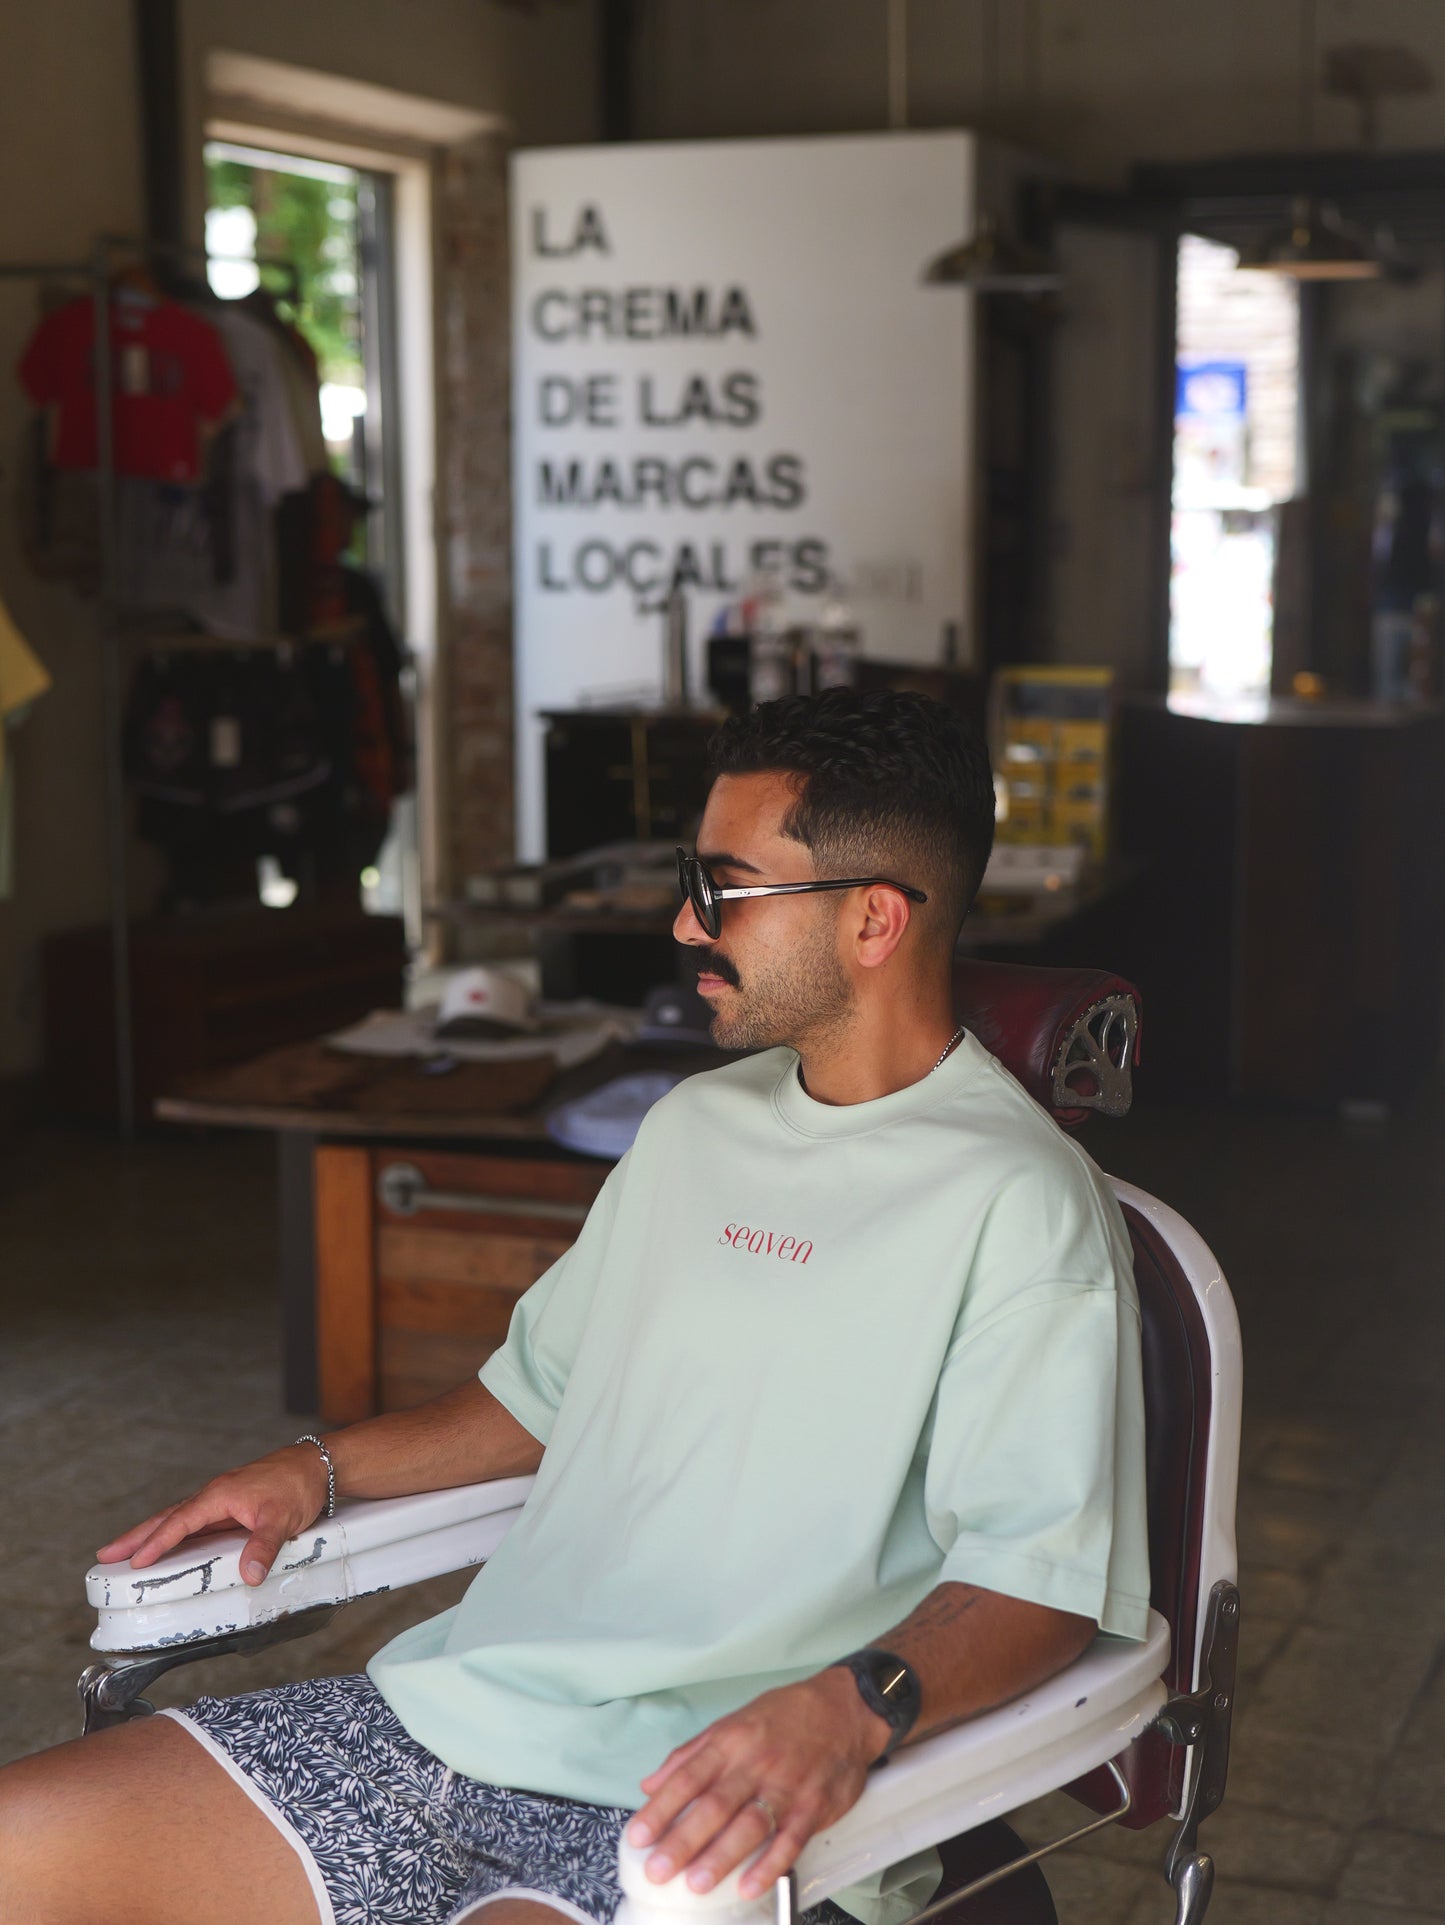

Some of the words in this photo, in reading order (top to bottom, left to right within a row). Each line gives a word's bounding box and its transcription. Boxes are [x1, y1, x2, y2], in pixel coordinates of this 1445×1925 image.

[533, 204, 608, 257] LA
[533, 286, 757, 340] CREMA
[540, 375, 617, 427] DE
[640, 372, 762, 427] LAS
[540, 456, 806, 509] MARCAS
[717, 1223, 813, 1264] seaven
